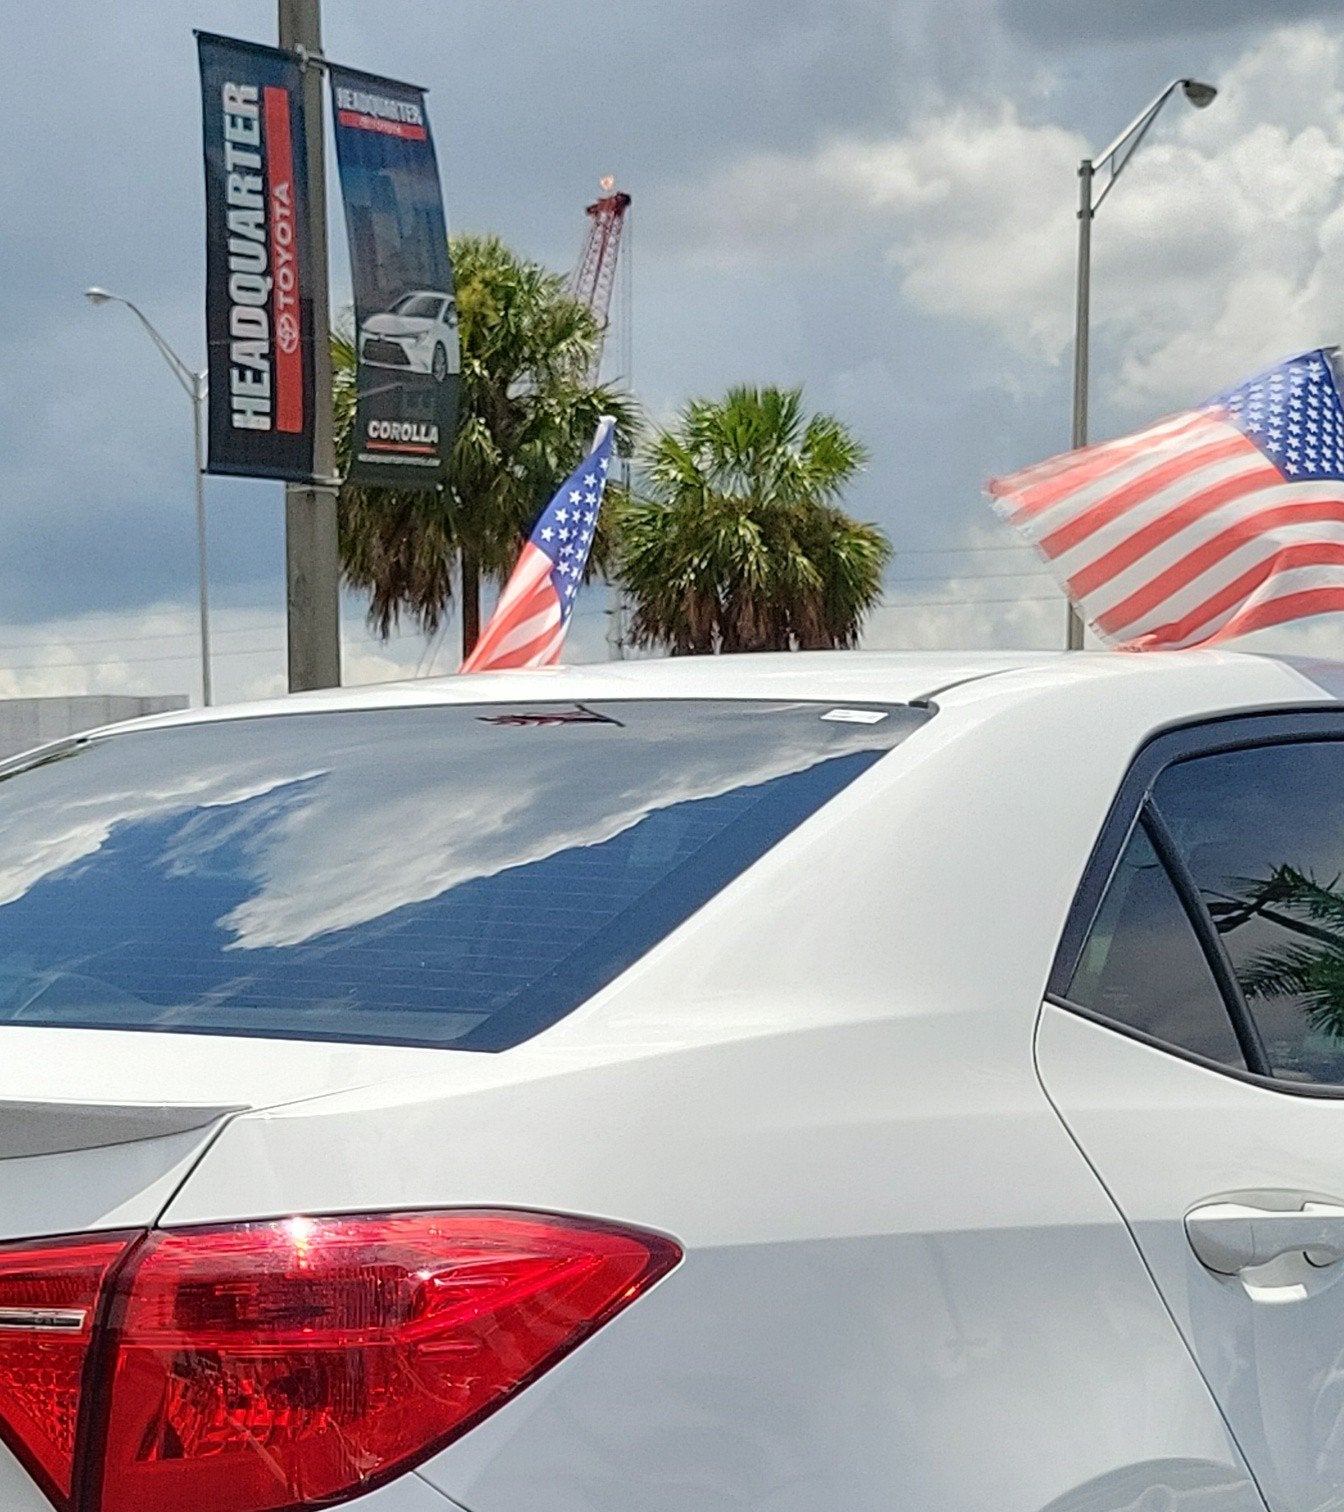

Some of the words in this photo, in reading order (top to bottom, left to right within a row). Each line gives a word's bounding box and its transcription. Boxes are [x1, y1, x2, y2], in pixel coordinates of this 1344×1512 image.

[222, 81, 273, 431] HEADQUARTER
[271, 182, 299, 312] TOYOTA
[368, 420, 439, 443] COROLLA
